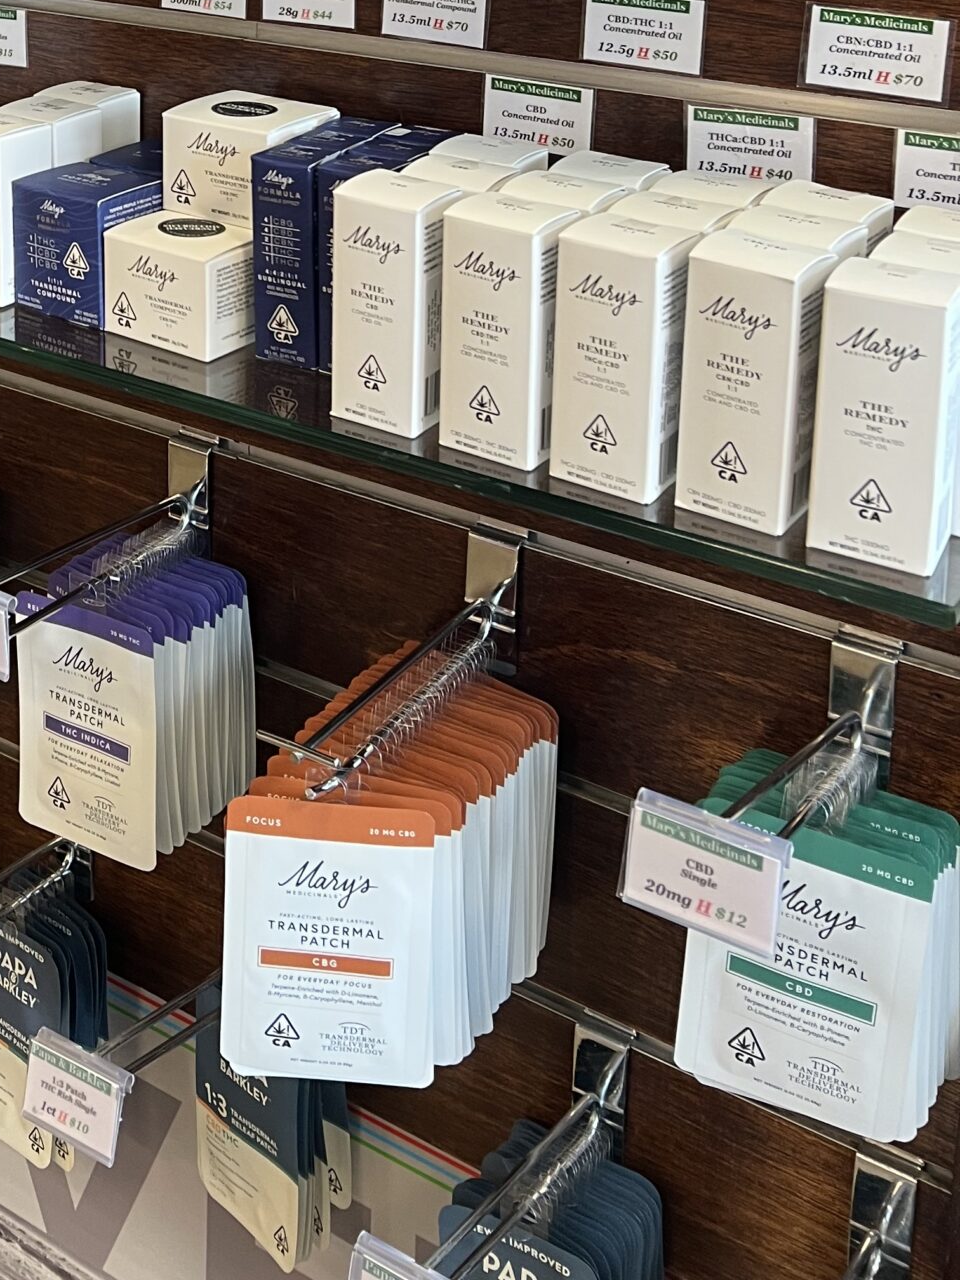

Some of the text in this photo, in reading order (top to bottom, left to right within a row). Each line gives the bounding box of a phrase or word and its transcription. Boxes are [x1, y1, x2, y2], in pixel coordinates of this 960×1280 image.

[391, 13, 431, 26] 13.5ml
[446, 20, 468, 32] $70
[603, 23, 682, 40] Concentrated Oil
[607, 14, 674, 31] CBD:THC 1:1
[822, 11, 928, 33] Mary's Medicinals
[598, 41, 635, 58] 12.5g
[652, 48, 678, 62] $50
[818, 63, 872, 81] 13.5ml
[894, 74, 923, 87] $70
[494, 80, 578, 101] Mary's Medicinals
[525, 105, 547, 115] CBD
[696, 109, 794, 129] Mary's Medicinals
[707, 142, 792, 158] Concentrated Oil
[708, 132, 785, 148] THCa:CBD 1:1
[697, 160, 747, 177] 13.5ml
[765, 166, 793, 181] $40
[343, 226, 405, 264] Mary's
[128, 255, 179, 291] Mary's
[836, 327, 928, 372] Mary's
[843, 407, 909, 429] REMEDY
[859, 400, 894, 415] THE
[52, 646, 118, 693] Mary's
[49, 690, 126, 727] TRANSDERMAL
[69, 709, 105, 729] PATCH
[61, 725, 112, 751] THC INDICA
[246, 816, 282, 827] FOCUS
[644, 814, 758, 868] Mary's Medicinals
[686, 858, 714, 876] CBD
[278, 860, 379, 909] Mary's
[680, 869, 718, 890] Single
[644, 878, 748, 929] 20mg H $12
[268, 919, 385, 941] TRANSDERMAL
[301, 935, 351, 950] PATCH
[312, 958, 338, 968] CBG
[774, 954, 830, 982] PATCH
[785, 980, 813, 997] CBD
[272, 1038, 292, 1048] CA
[734, 1051, 756, 1067] CA
[204, 1082, 227, 1118] 1:3
